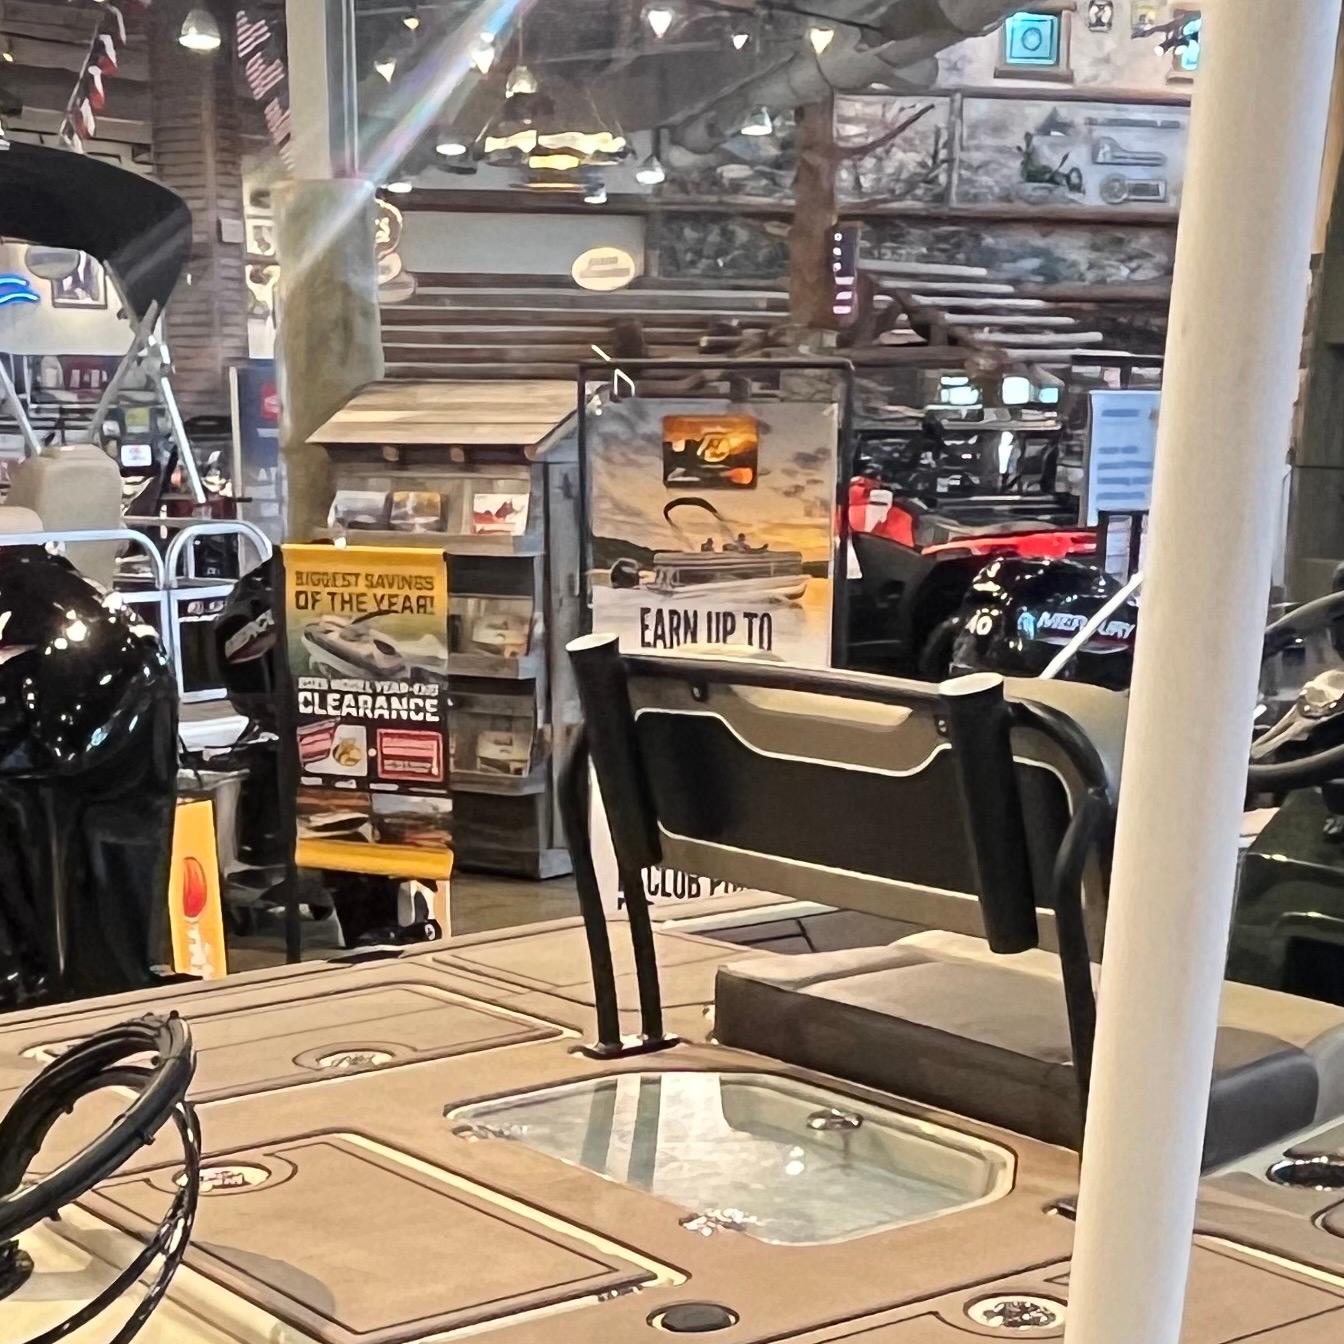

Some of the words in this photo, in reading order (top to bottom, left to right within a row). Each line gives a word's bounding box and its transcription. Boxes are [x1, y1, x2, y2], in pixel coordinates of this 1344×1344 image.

[295, 571, 361, 588] BIGGEST
[365, 573, 435, 591] SAVINGS
[295, 590, 322, 611] OF
[327, 591, 367, 613] THE
[372, 593, 435, 615] YEAR!
[640, 607, 698, 650] EARN
[706, 610, 737, 645] UP
[743, 612, 773, 652] TO
[1037, 610, 1135, 639] MERURY
[298, 691, 440, 722] CLEARANCE
[648, 866, 701, 899] CLUB
